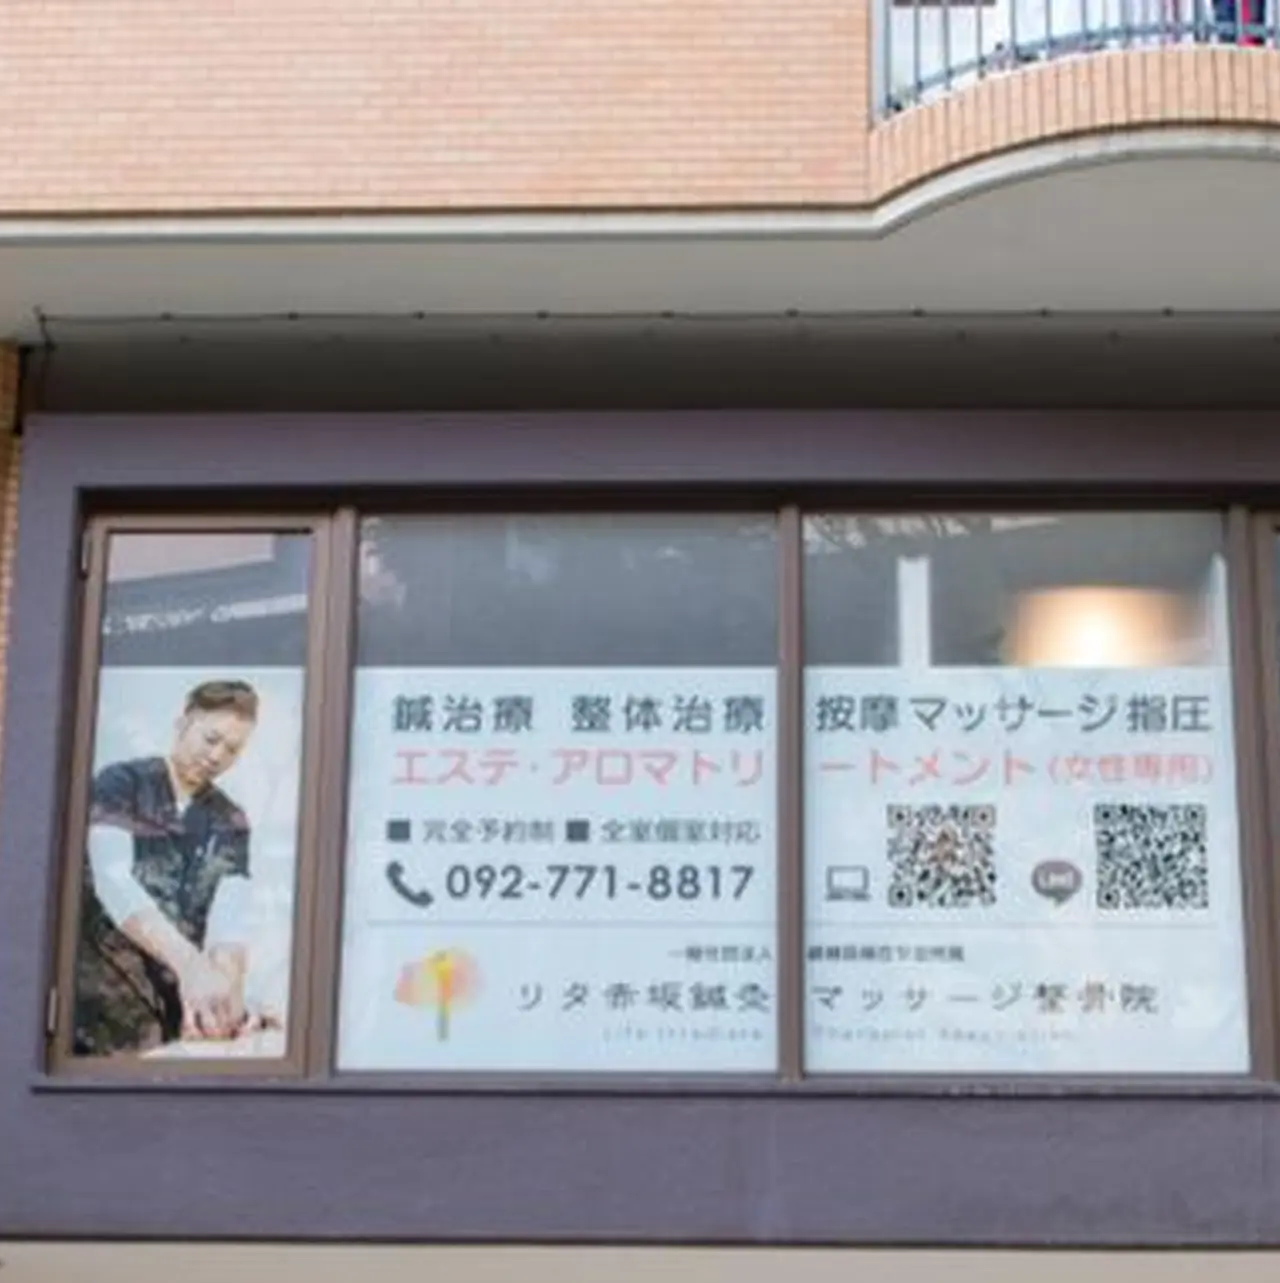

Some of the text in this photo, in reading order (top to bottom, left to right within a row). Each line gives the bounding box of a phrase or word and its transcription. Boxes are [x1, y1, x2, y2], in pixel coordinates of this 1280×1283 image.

[392, 693, 1213, 735] 鍼治療 整体治療 按摩マッサージ指圧
[445, 864, 755, 900] 092-771-8817
